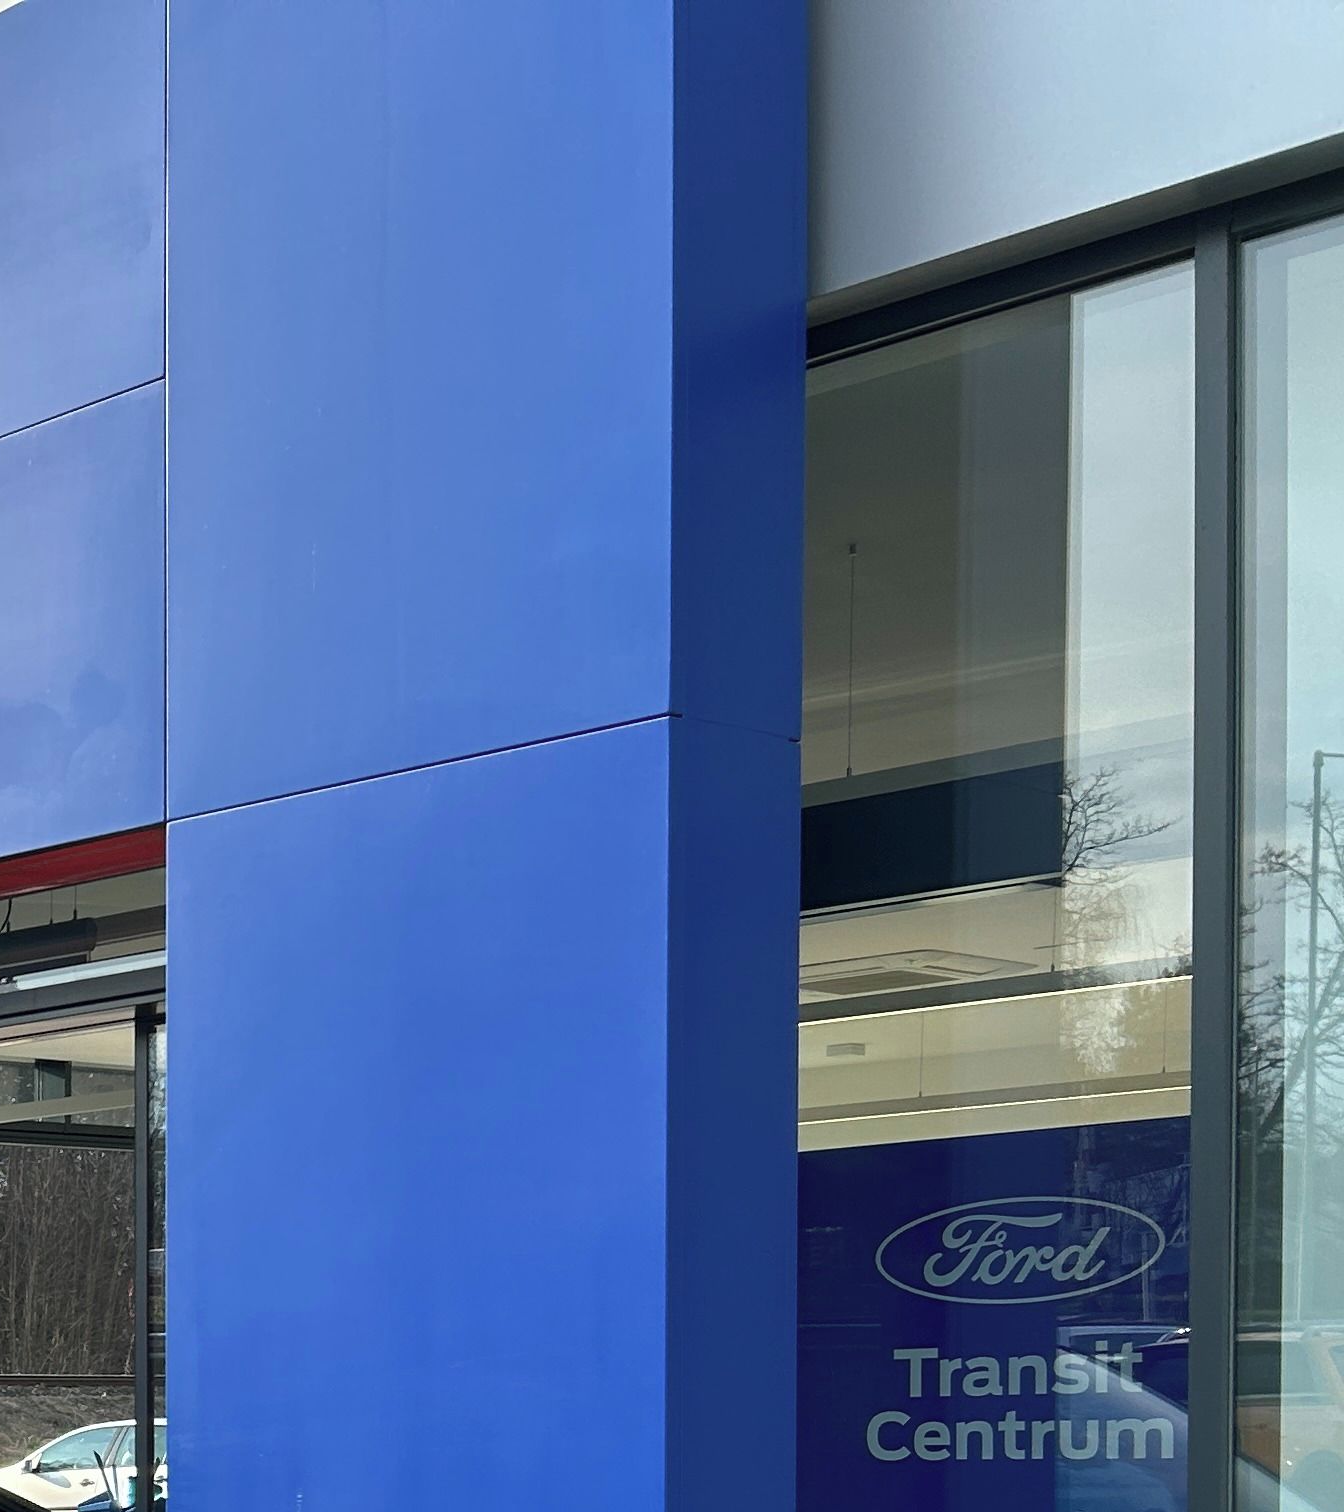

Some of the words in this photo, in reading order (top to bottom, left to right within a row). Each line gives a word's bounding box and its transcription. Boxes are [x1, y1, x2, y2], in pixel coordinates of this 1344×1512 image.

[922, 1212, 1112, 1287] Ford
[892, 1341, 1144, 1399] Transit
[865, 1410, 1175, 1462] Centrum
